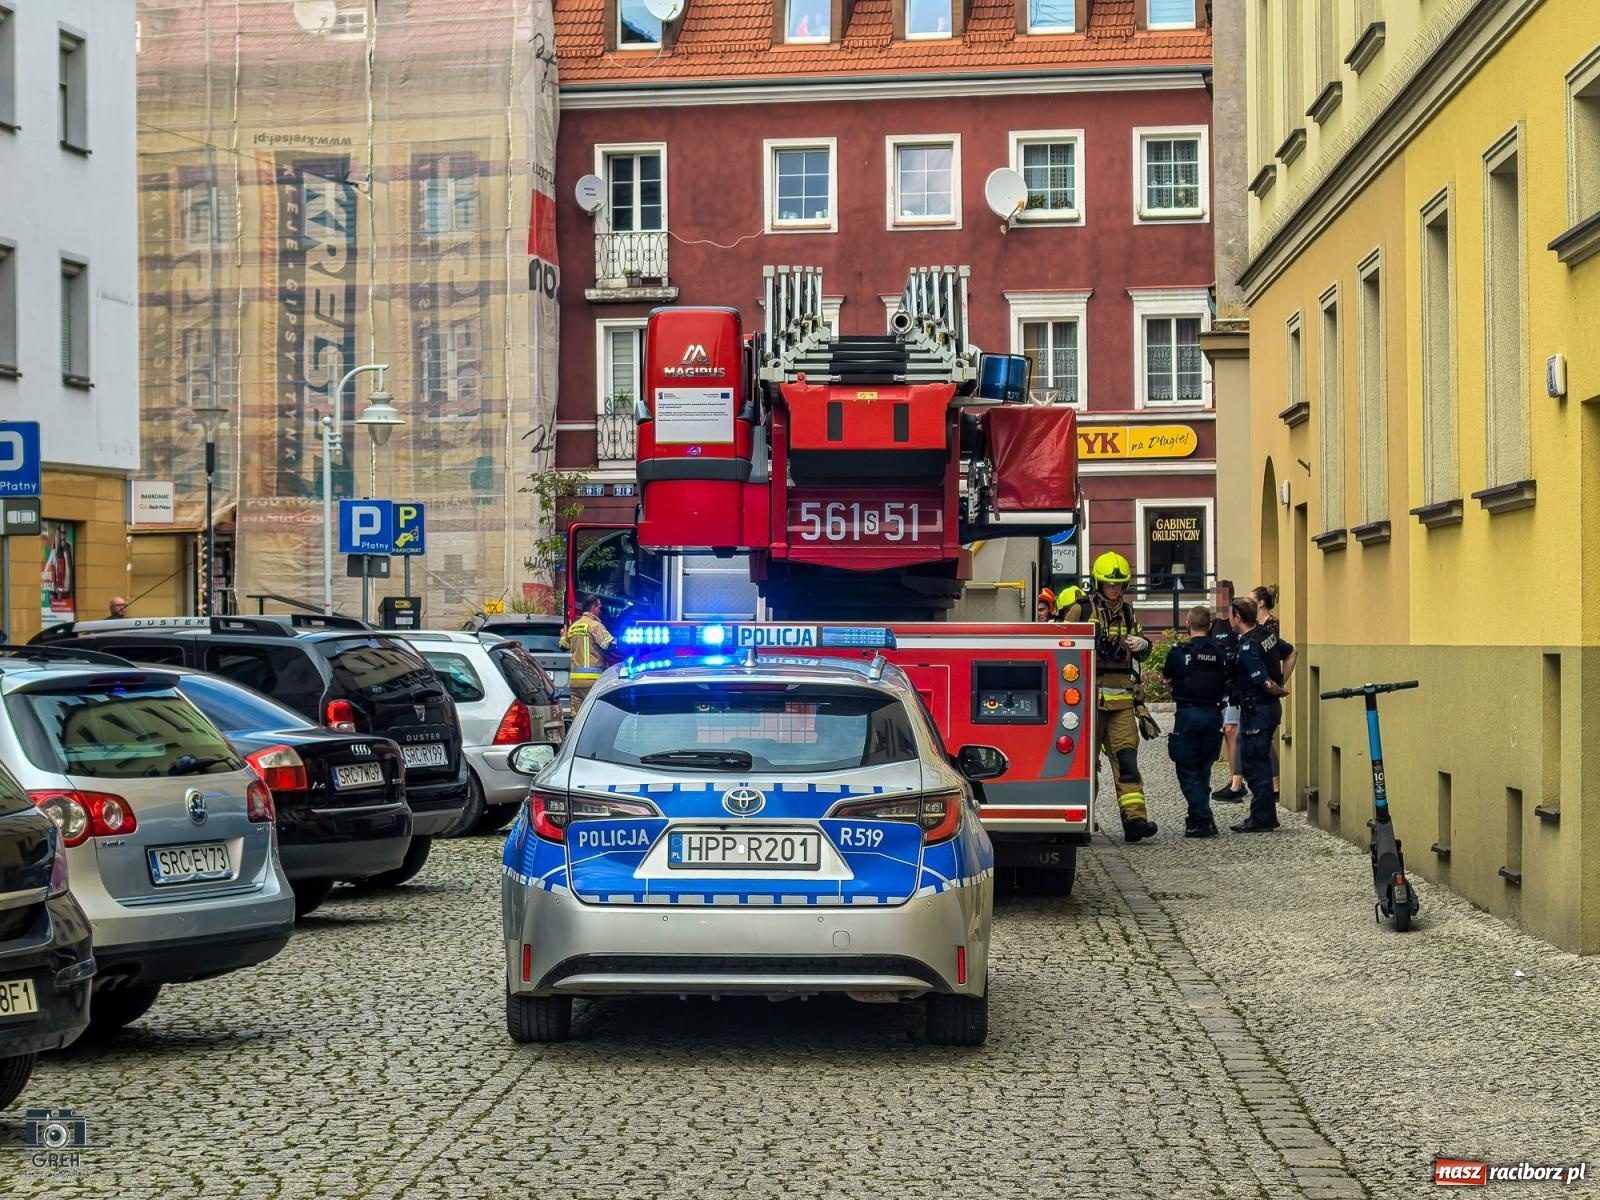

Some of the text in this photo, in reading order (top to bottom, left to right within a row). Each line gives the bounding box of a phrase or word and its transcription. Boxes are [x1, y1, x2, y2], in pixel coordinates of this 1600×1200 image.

[283, 279, 298, 363] GIPSY
[303, 172, 348, 482] KREISEL
[663, 367, 726, 378] MAGIRUS
[1131, 443, 1144, 451] na
[0, 481, 36, 492] Płatny
[400, 506, 417, 528] P
[801, 502, 919, 541] 561 S 51
[1156, 518, 1198, 530] GABINET
[352, 506, 381, 547] P
[1152, 530, 1200, 541] OKULISTYCZNY
[361, 542, 389, 550] Płatny
[1052, 548, 1076, 556] otyczy
[134, 618, 206, 626] DUSTER
[741, 628, 813, 646] POLICJA
[406, 733, 441, 741] DUSTER
[406, 745, 443, 763] SRC RY99
[339, 767, 358, 785] SRC
[579, 829, 650, 847] POLICJA
[687, 836, 809, 861] HPP R201
[159, 847, 226, 875] SRC EY73
